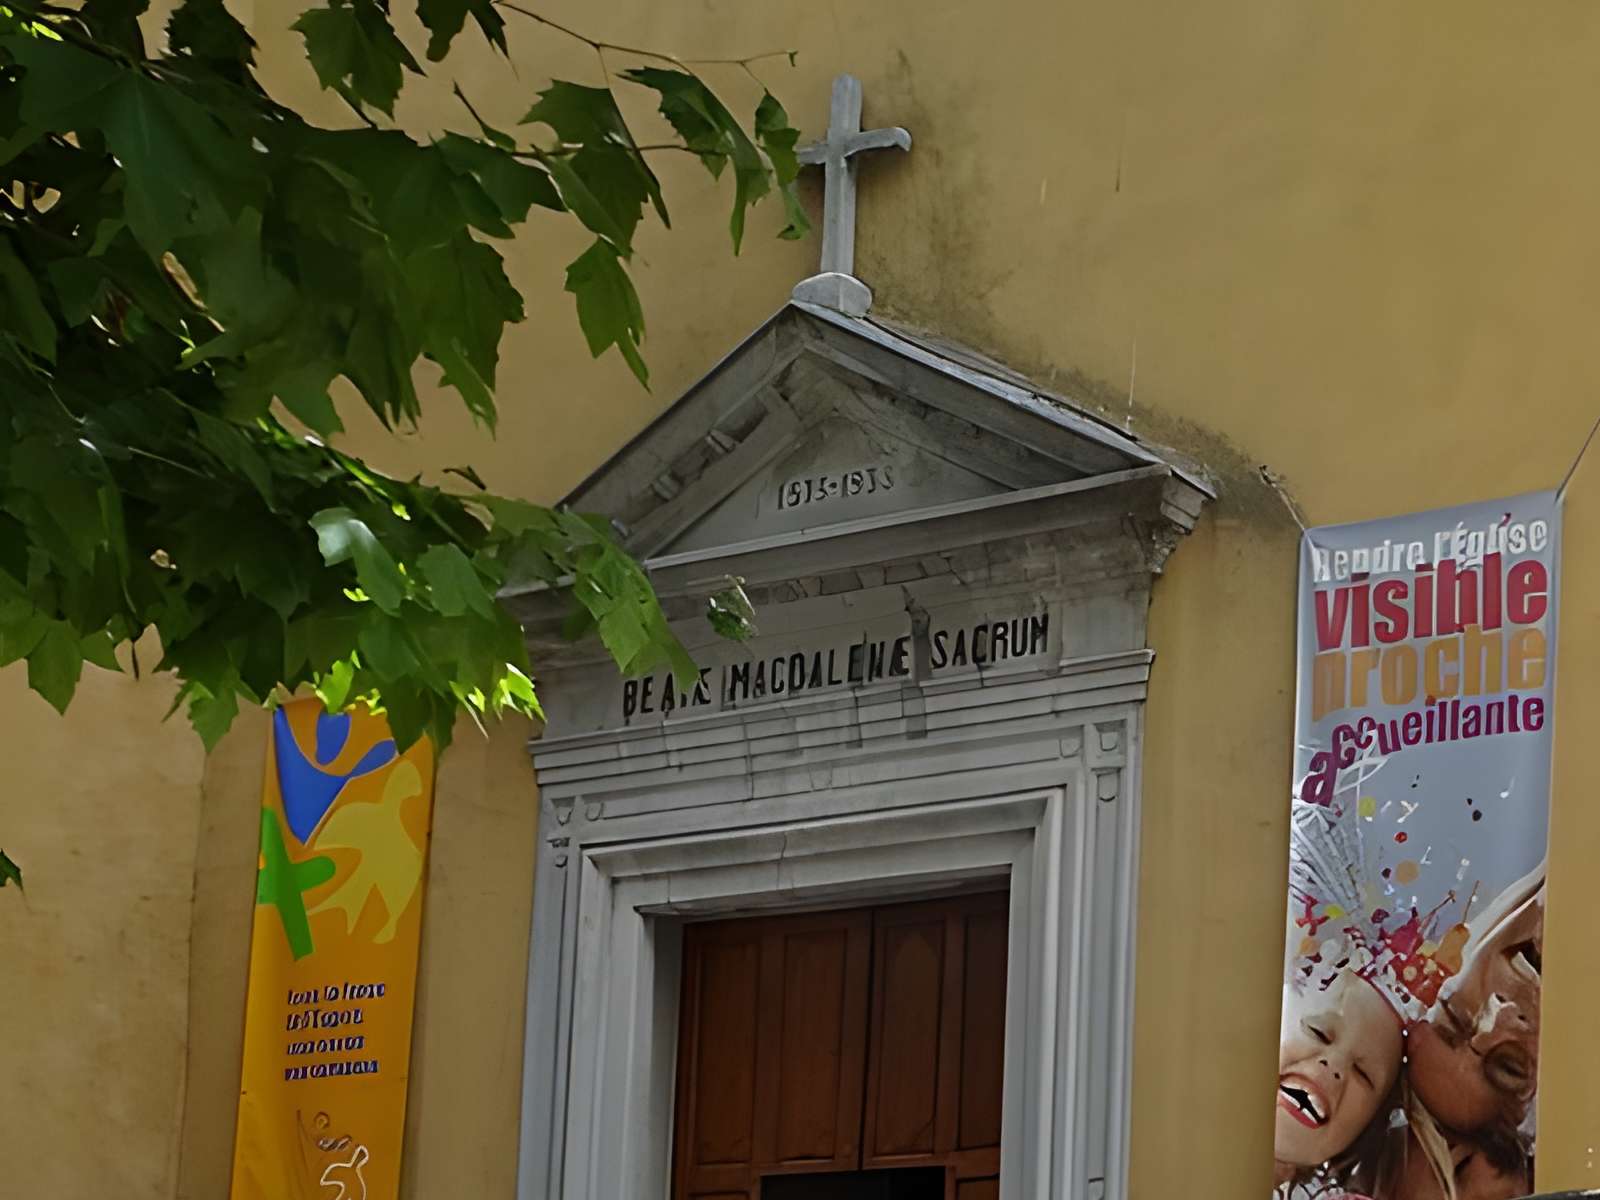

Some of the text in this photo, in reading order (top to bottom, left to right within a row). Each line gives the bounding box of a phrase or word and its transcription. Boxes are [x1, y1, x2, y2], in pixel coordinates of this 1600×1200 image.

[1312, 539, 1426, 583] Rendre
[1314, 552, 1547, 651] visible
[931, 613, 1049, 670] SACRUM
[1312, 624, 1546, 723] proche
[1301, 695, 1545, 808] accueillante
